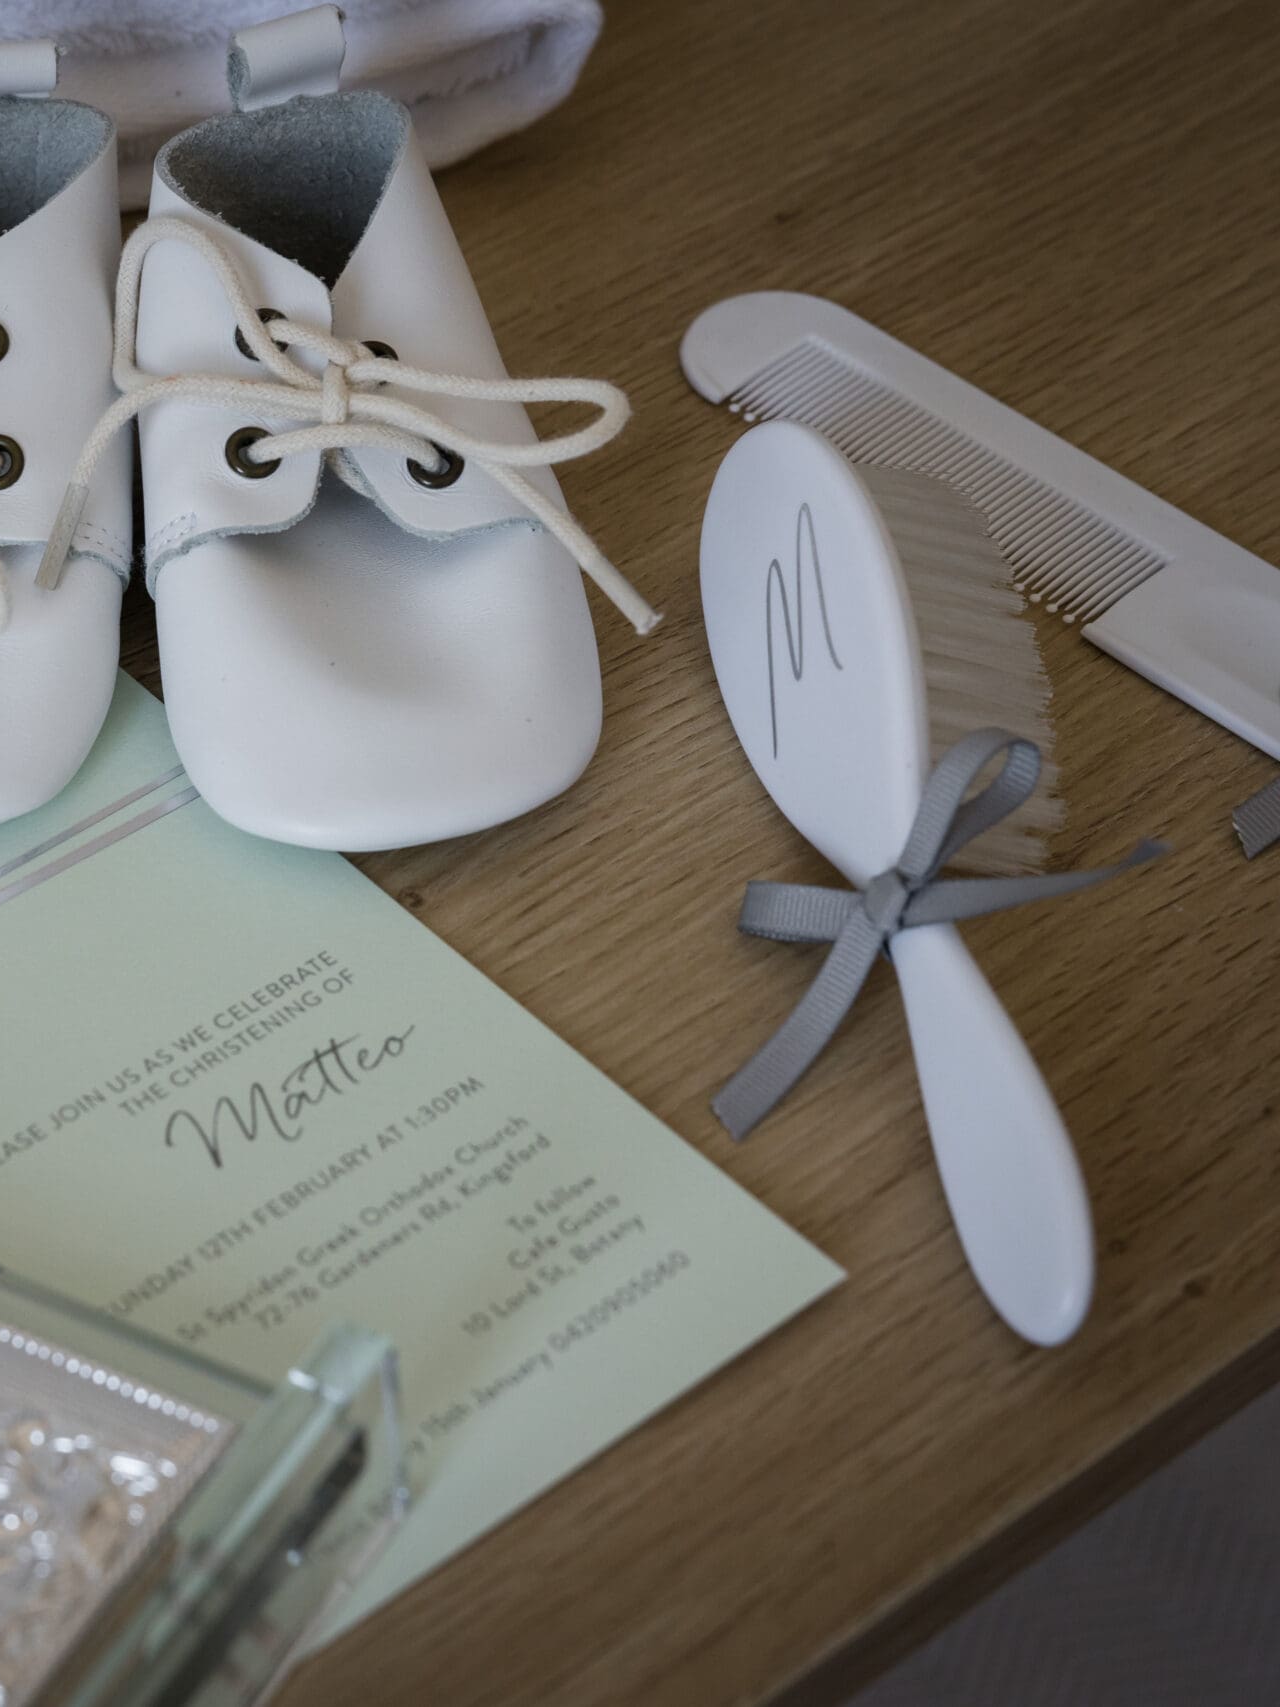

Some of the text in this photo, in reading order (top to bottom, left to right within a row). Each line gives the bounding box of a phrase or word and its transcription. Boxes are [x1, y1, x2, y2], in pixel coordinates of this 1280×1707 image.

[765, 502, 843, 760] M
[48, 1087, 106, 1131] JOIN
[105, 1067, 141, 1094] US
[143, 1048, 174, 1074] AS
[171, 1024, 213, 1052] WE
[212, 950, 338, 1030] CELEBRATE
[118, 967, 354, 1117] THE CHRISTENING OF
[165, 1023, 415, 1169] Matteo
[196, 1219, 253, 1261] 12TH
[252, 1143, 372, 1226] FEBRUARY
[376, 1124, 404, 1150] AT
[404, 1076, 486, 1130] 1:30PM
[204, 1265, 297, 1325] Spyridon
[296, 1224, 360, 1267] Greek
[359, 1165, 455, 1228] Orthodox
[454, 1115, 529, 1165] Church
[318, 1221, 421, 1289] Gardeners
[456, 1132, 551, 1198] Kingsford
[505, 1176, 596, 1233] To follow
[557, 1194, 621, 1236] Gusto
[488, 1278, 542, 1319] Lord
[570, 1213, 646, 1265] Botany
[470, 1351, 554, 1408] January
